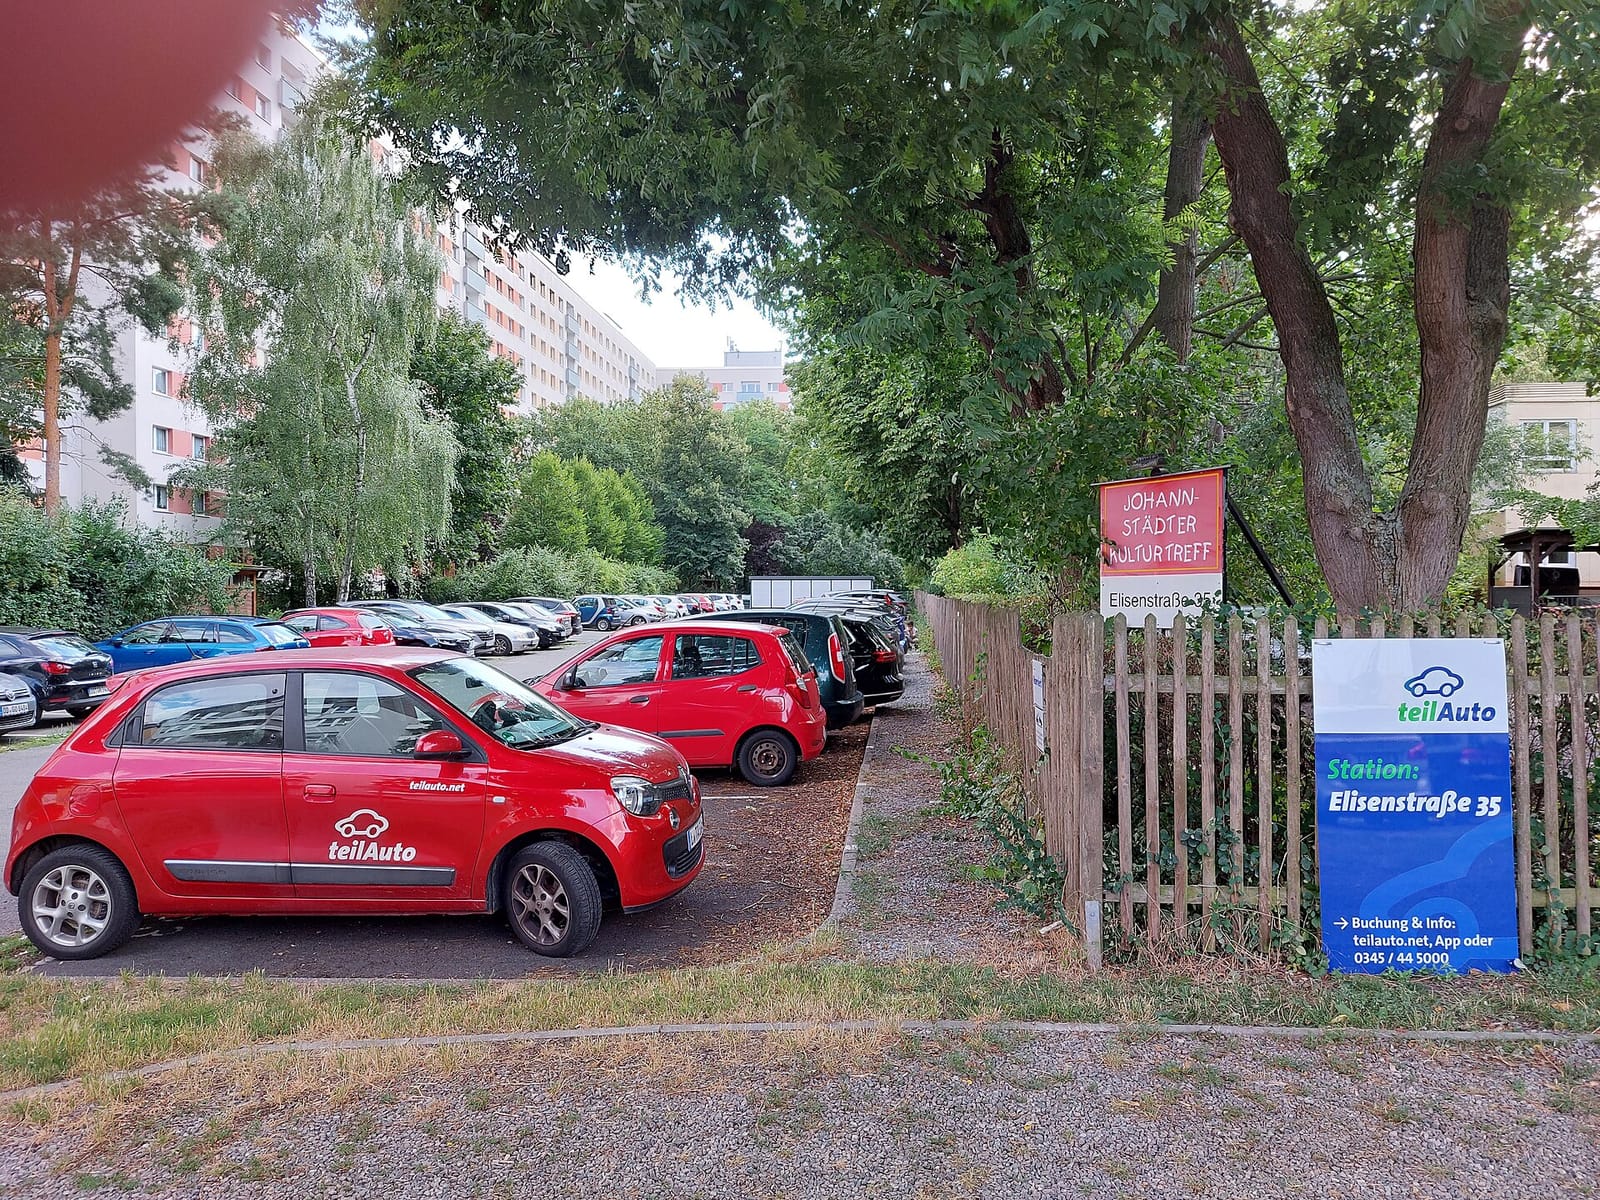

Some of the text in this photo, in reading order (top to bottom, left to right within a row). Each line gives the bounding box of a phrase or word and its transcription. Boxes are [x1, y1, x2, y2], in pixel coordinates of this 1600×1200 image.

[1123, 488, 1199, 511] JOHANN-
[1122, 515, 1196, 536] STÄDTER
[1109, 592, 1189, 607] Elisenstraße
[1398, 700, 1496, 722] teilAuto
[1328, 758, 1419, 779] Station:
[409, 781, 465, 792] teilauto.net
[1329, 790, 1502, 818] Elisenstraße 35
[328, 840, 417, 862] teilAuto
[1352, 917, 1457, 933] Buchung & Info:
[1353, 934, 1494, 950] teilauto.net, App oder
[1354, 952, 1450, 964] 0345 / 44 5000
